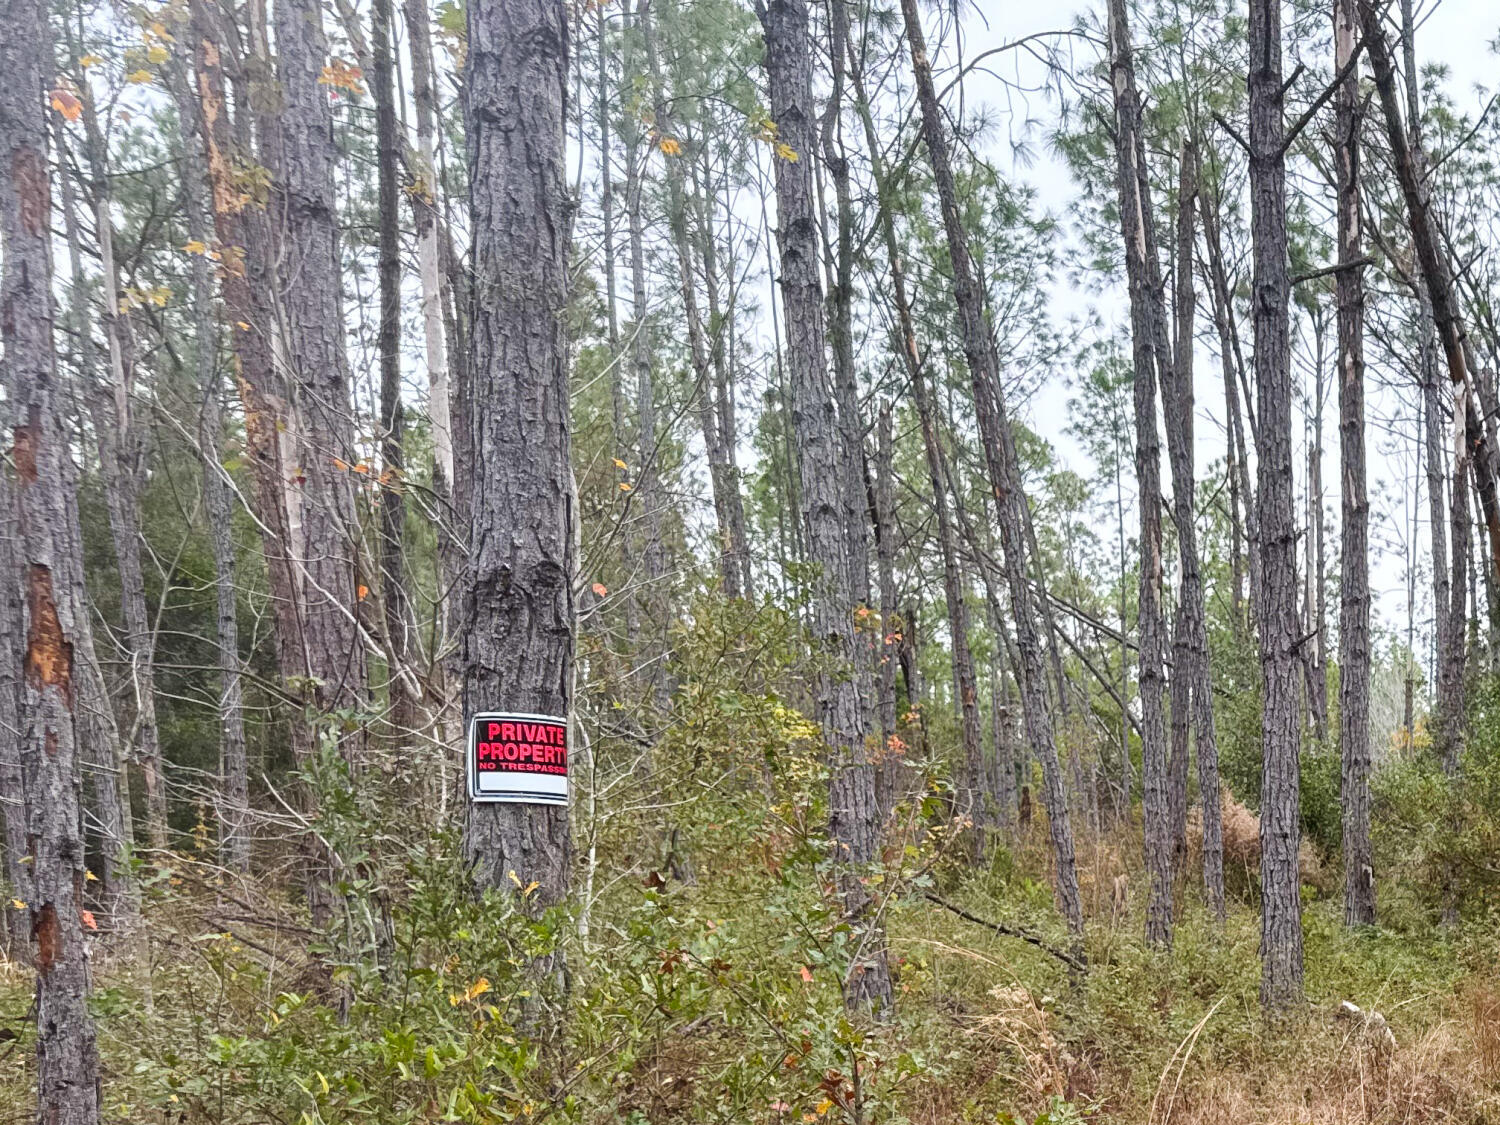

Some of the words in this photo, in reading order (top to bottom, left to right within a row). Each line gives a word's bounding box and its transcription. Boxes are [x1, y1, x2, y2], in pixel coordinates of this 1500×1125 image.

[488, 723, 565, 745] PRIVATE
[479, 762, 497, 770] NO
[500, 762, 567, 774] TRESPASS
